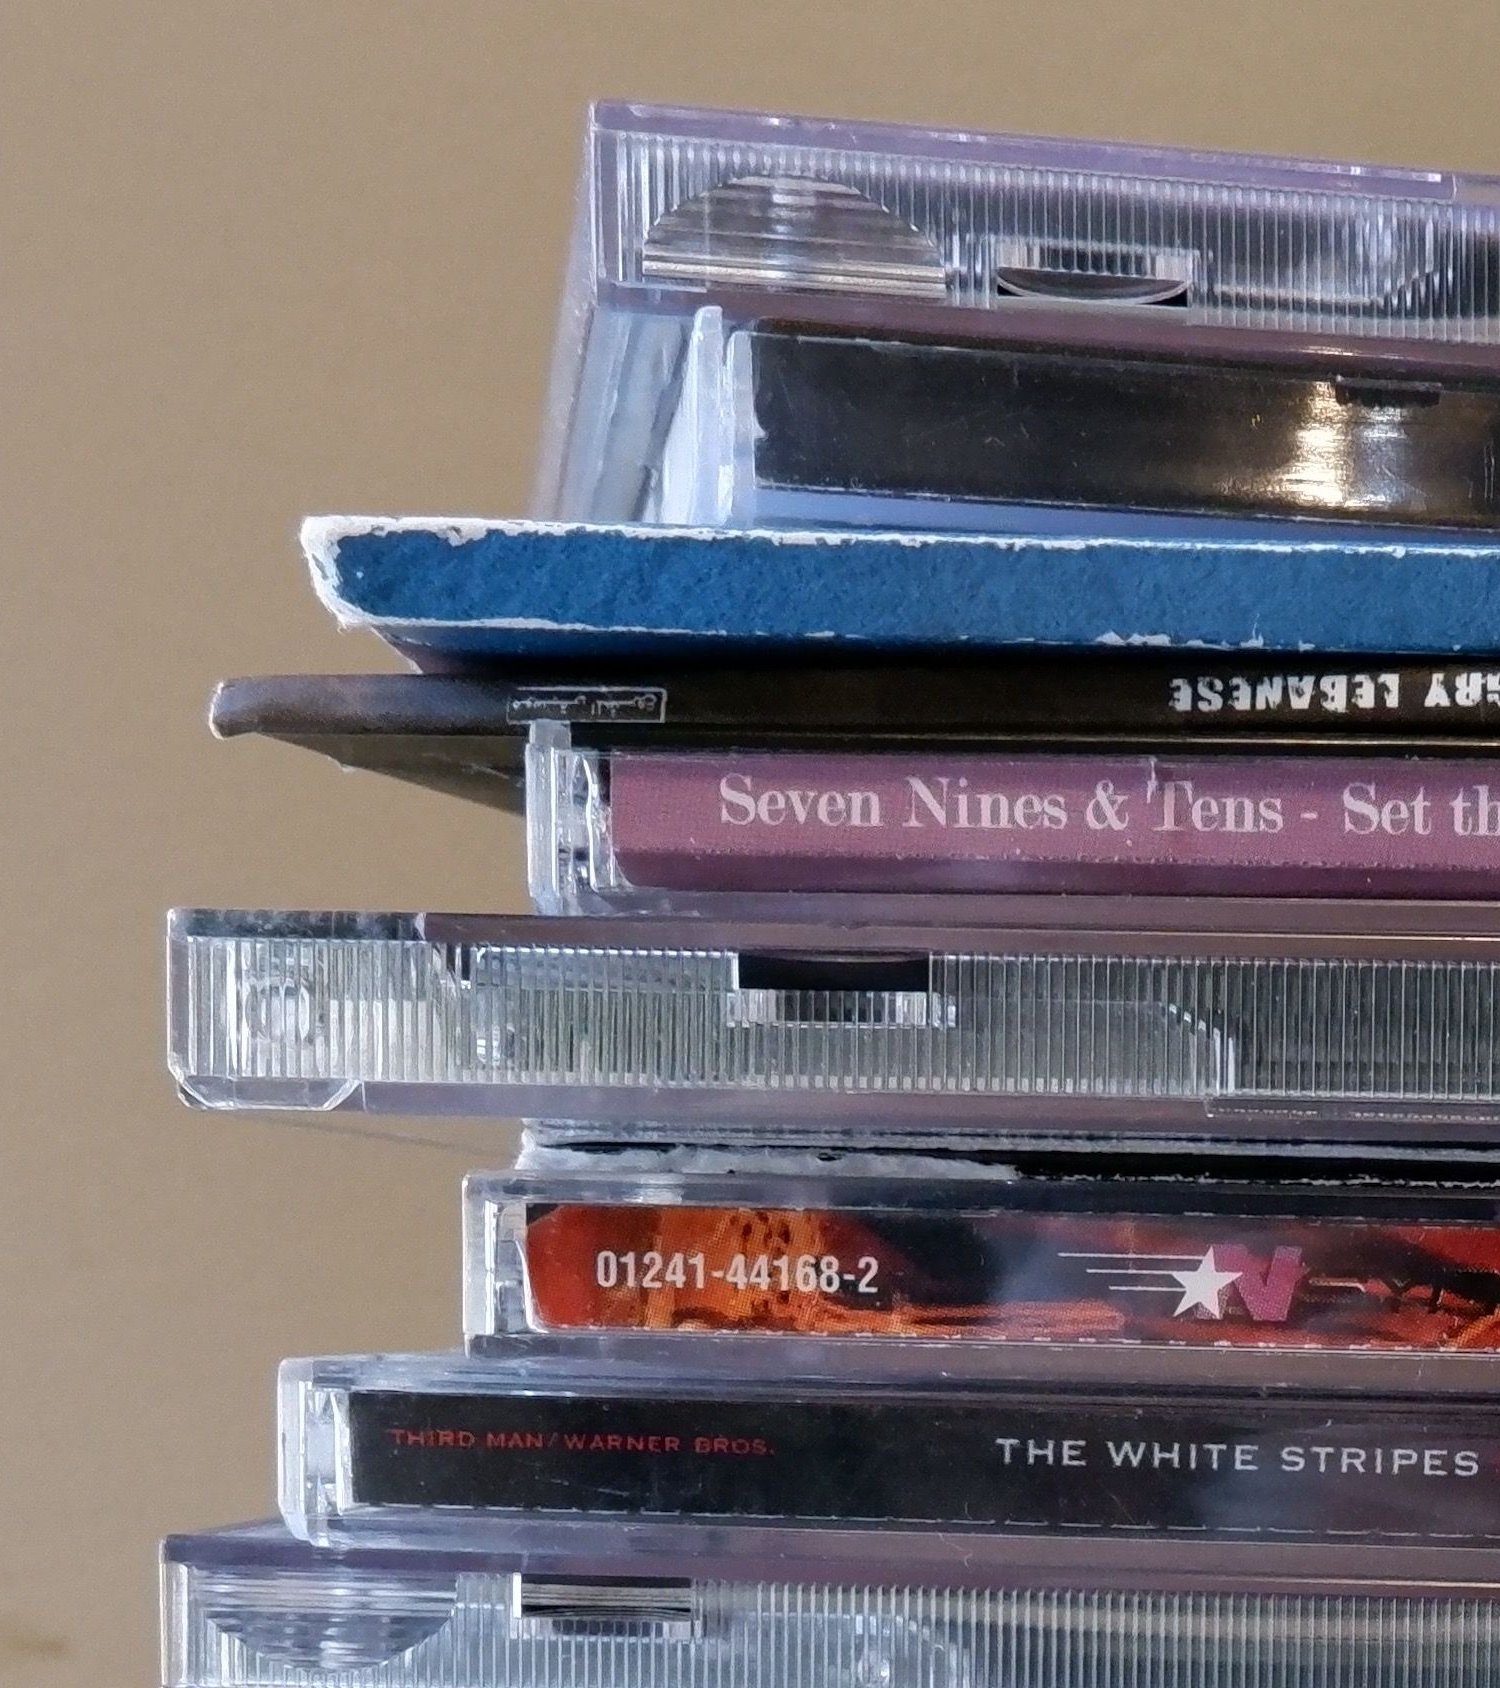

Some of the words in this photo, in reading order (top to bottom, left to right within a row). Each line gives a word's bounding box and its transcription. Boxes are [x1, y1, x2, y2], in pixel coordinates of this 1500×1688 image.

[1169, 673, 1400, 713] LEBANESE
[719, 772, 884, 827] Seven
[903, 776, 1066, 830] Nines
[1085, 781, 1129, 831] &
[1148, 780, 1283, 834] Tens
[1342, 782, 1430, 837] Set
[596, 1250, 878, 1293] 01241-44168-2
[389, 1428, 475, 1450] THIRD
[695, 1435, 775, 1456] BROS.
[995, 1437, 1088, 1467] THE
[1106, 1441, 1260, 1471] WHITE
[1279, 1445, 1481, 1477] STRIPES
